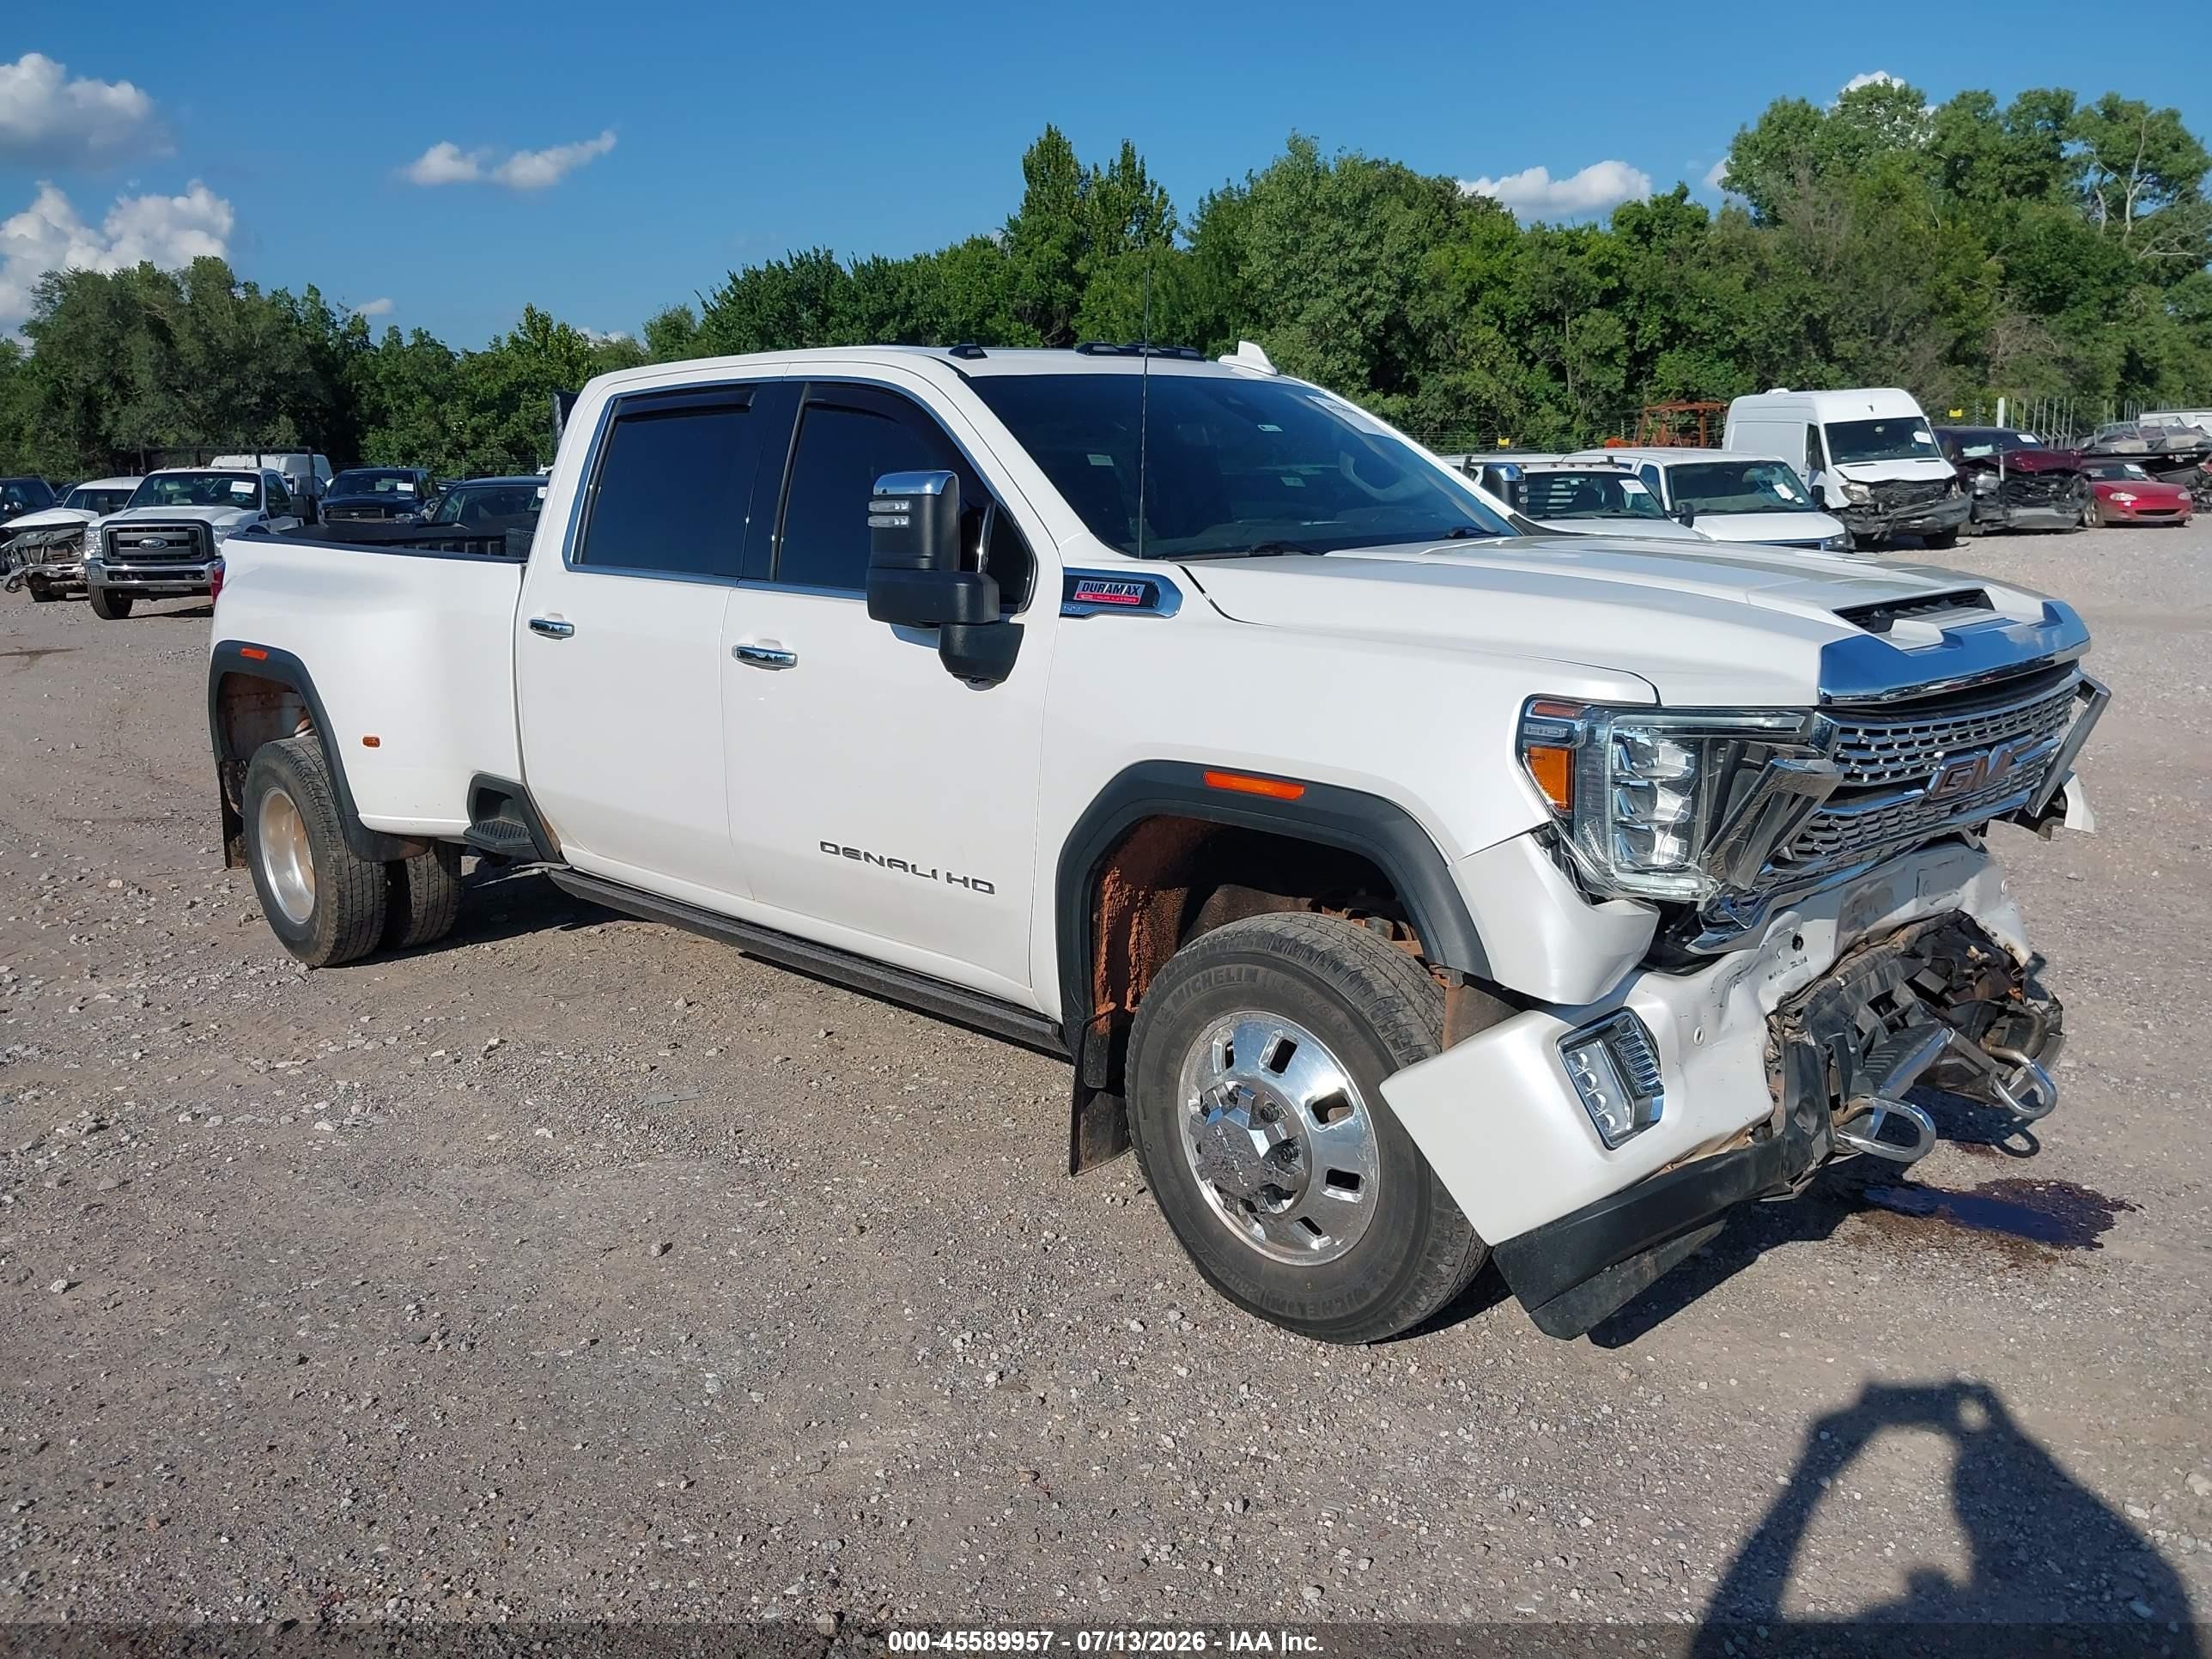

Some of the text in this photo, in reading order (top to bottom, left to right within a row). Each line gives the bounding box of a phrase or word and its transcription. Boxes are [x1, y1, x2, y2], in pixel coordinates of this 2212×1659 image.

[1082, 582, 1141, 596] DURAMAX
[820, 841, 995, 895] DENALI HD
[1170, 964, 1259, 1008] MICHELIN
